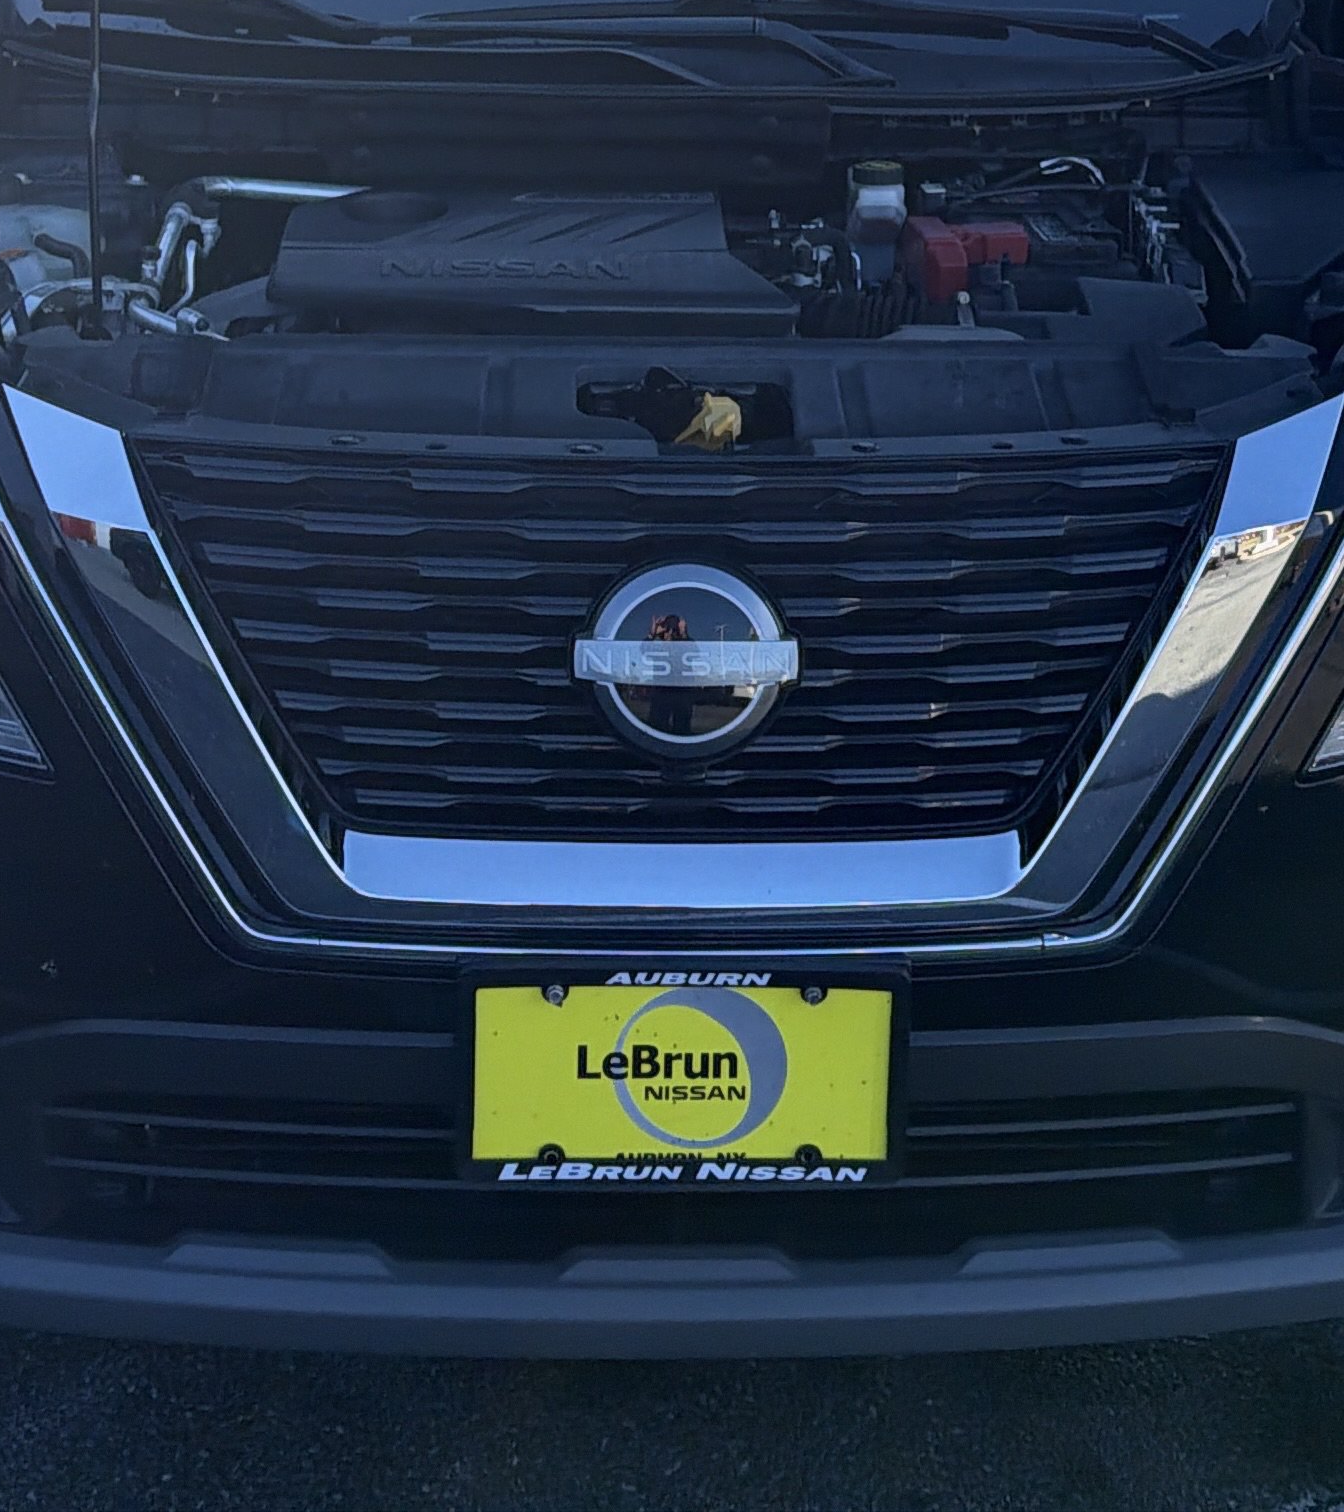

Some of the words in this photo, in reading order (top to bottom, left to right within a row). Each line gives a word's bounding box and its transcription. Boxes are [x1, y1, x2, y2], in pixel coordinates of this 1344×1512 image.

[379, 259, 631, 280] NISSAN
[581, 646, 792, 678] NISSAN
[605, 972, 771, 986] AUBURN
[576, 1044, 738, 1080] LeBrun
[644, 1085, 747, 1101] NISSAN
